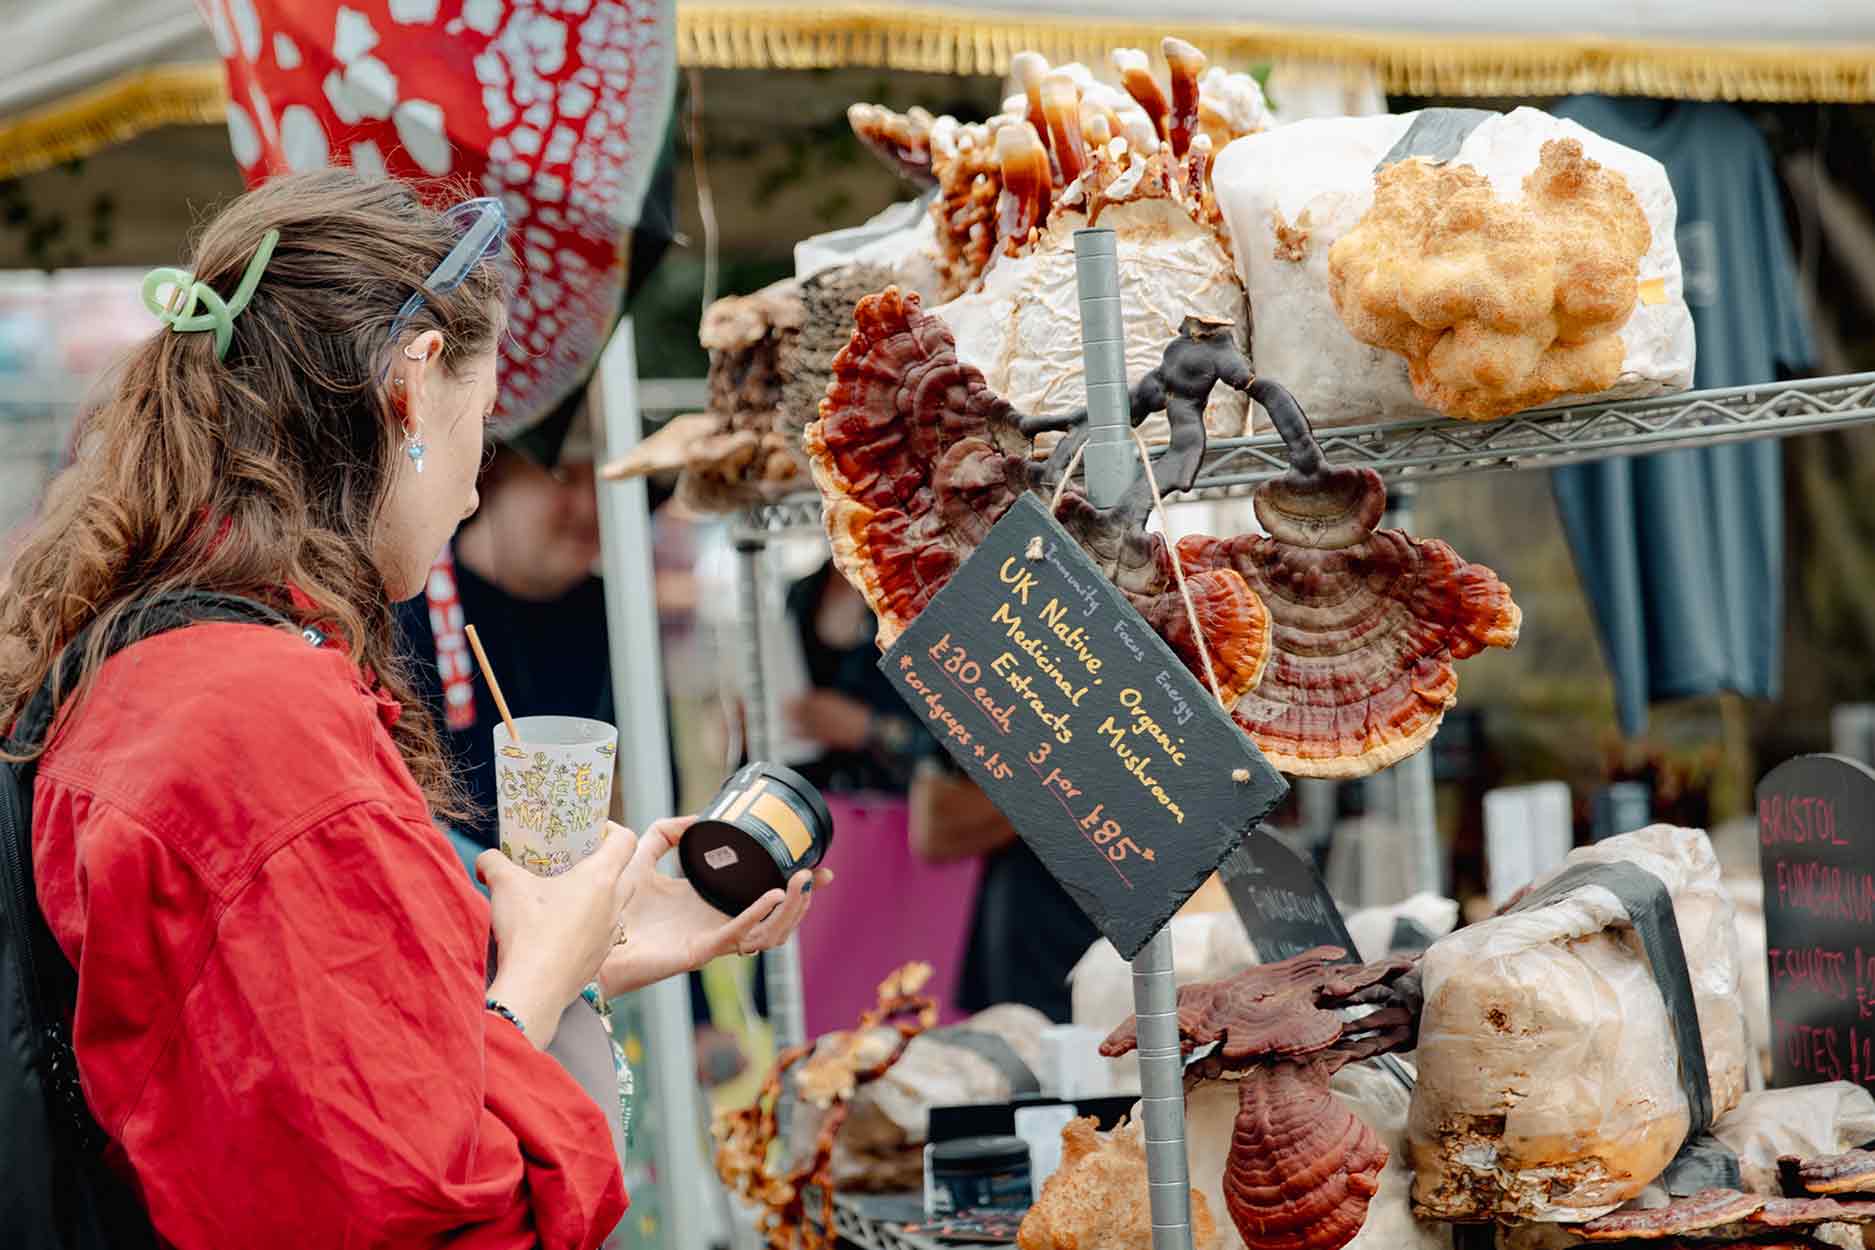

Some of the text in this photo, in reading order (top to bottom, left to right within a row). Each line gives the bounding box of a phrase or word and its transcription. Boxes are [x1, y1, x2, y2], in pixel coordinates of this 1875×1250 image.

[991, 652, 1073, 744] Extracts
[1000, 556, 1186, 766] UK Native, Organic
[1113, 619, 1145, 662] Focus
[1155, 670, 1195, 725] Energy
[974, 687, 1017, 733] each
[1028, 742, 1052, 764] 3
[991, 603, 1184, 824] Medicinal Mushroom
[1760, 794, 1849, 847] BRISTOL
